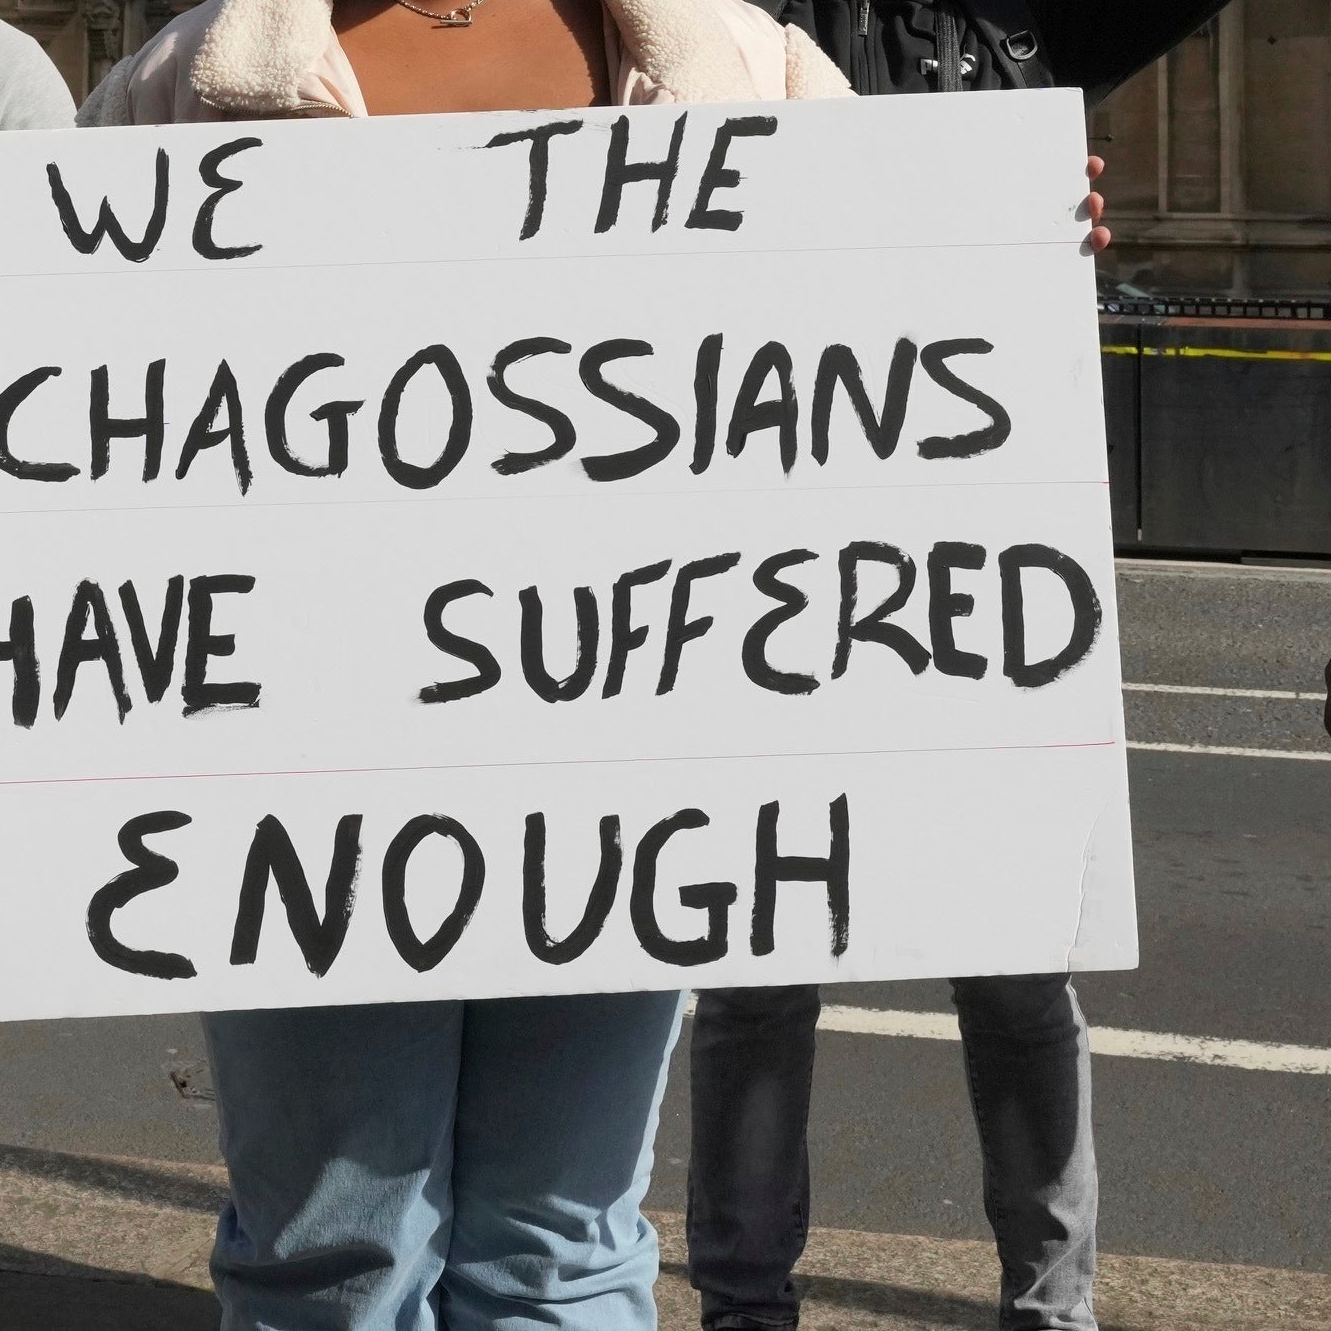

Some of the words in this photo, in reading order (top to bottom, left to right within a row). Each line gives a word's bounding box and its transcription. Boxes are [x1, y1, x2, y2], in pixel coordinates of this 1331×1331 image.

[47, 137, 263, 263] WE
[485, 114, 778, 241] THE
[418, 540, 1102, 704] SUFFERED
[87, 793, 851, 981] ENOUGH
